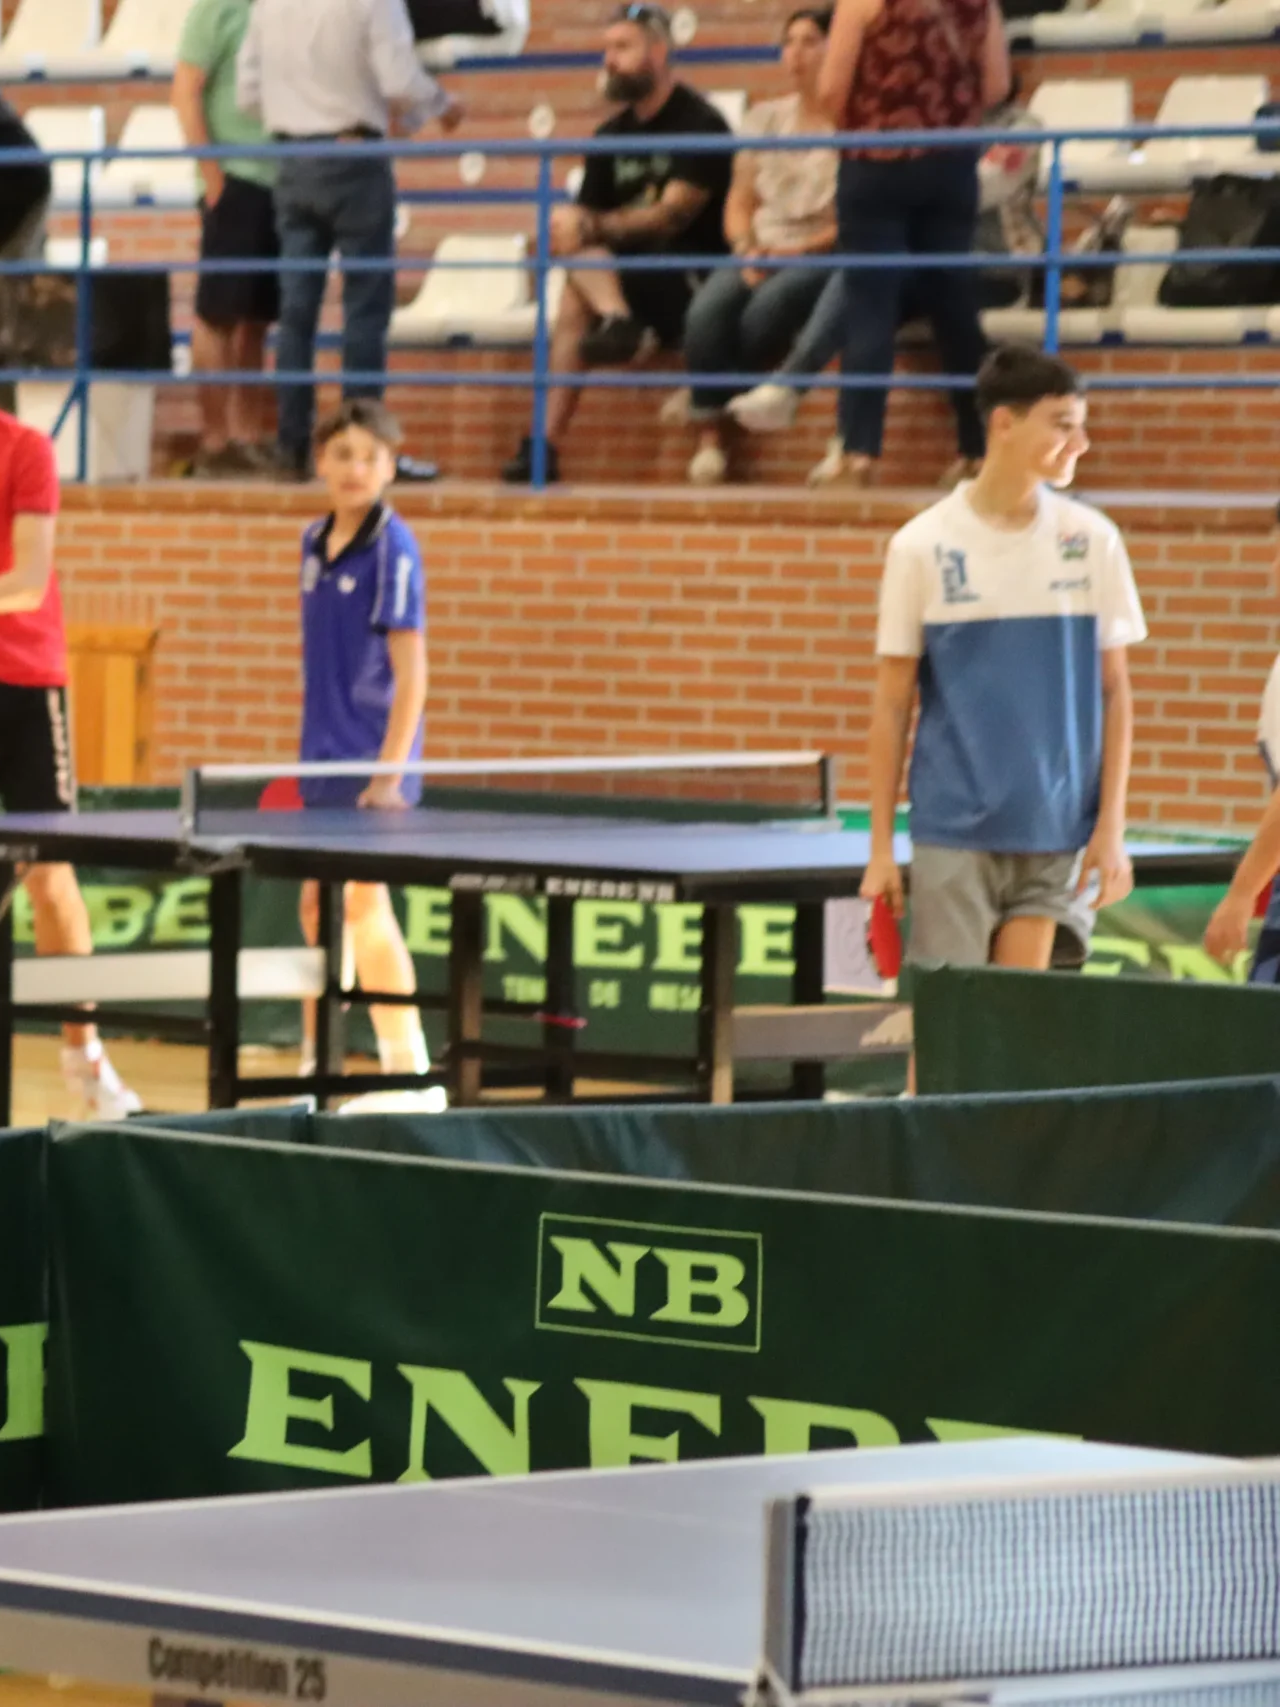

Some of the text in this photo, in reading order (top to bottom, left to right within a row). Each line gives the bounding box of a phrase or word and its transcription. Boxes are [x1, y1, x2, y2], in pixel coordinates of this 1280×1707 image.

[547, 1236, 751, 1328] NB
[148, 1636, 327, 1702] Competition 25
